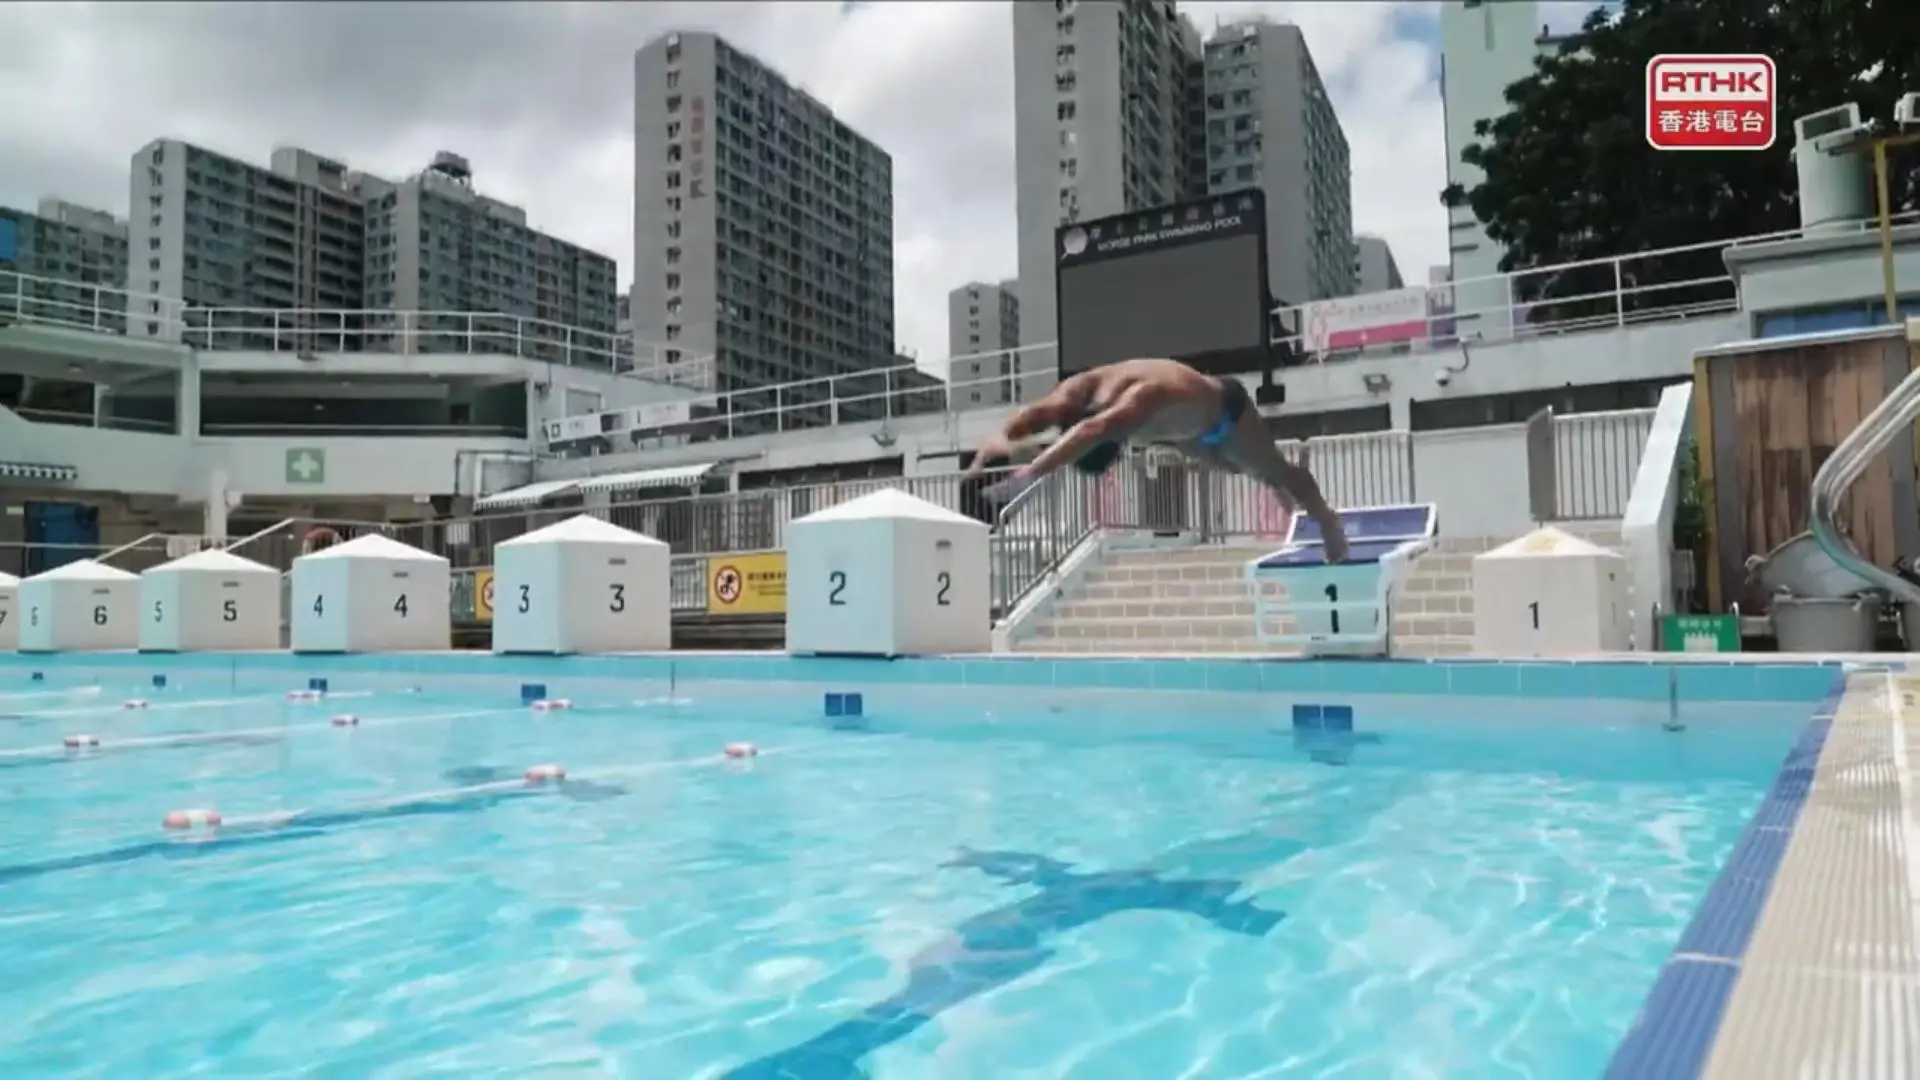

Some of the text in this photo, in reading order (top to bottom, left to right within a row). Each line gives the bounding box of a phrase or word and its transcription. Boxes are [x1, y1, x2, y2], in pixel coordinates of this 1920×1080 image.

[1133, 232, 1159, 245] PARK
[518, 584, 531, 614] 3
[608, 584, 626, 613] 3
[829, 570, 847, 606] 2
[937, 571, 951, 606] 2
[93, 605, 108, 626] 6
[154, 600, 163, 623] 5
[223, 600, 238, 622] 5
[313, 594, 324, 617] 4
[393, 593, 409, 618] 4
[1324, 582, 1340, 634] 1
[1528, 600, 1540, 630] 1
